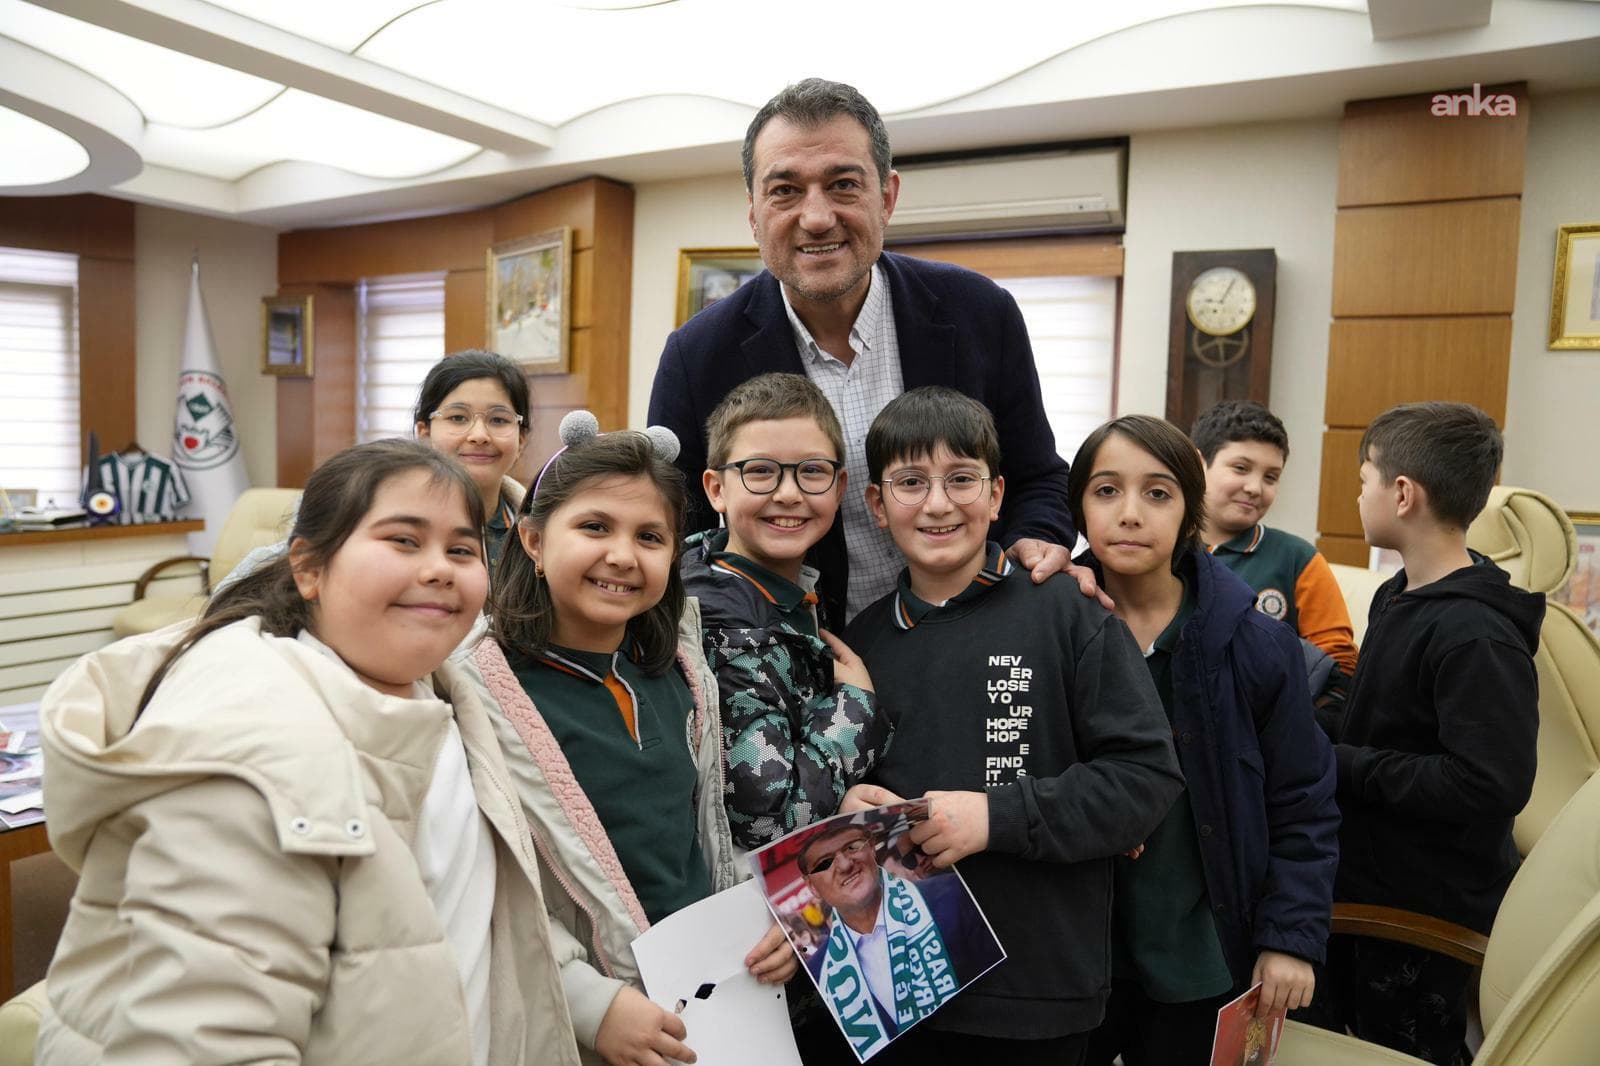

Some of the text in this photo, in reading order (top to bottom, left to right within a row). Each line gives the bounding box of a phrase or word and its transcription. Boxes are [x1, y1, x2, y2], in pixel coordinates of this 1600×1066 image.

[988, 655, 1022, 667] NEV
[1010, 667, 1033, 680] ER
[987, 679, 1030, 692] LOSE
[1009, 705, 1033, 717] UR
[986, 718, 1028, 730] HOPE
[986, 730, 1020, 743] HOP
[1020, 743, 1030, 755] E
[986, 756, 1024, 769] FIND
[985, 769, 1002, 781] IT
